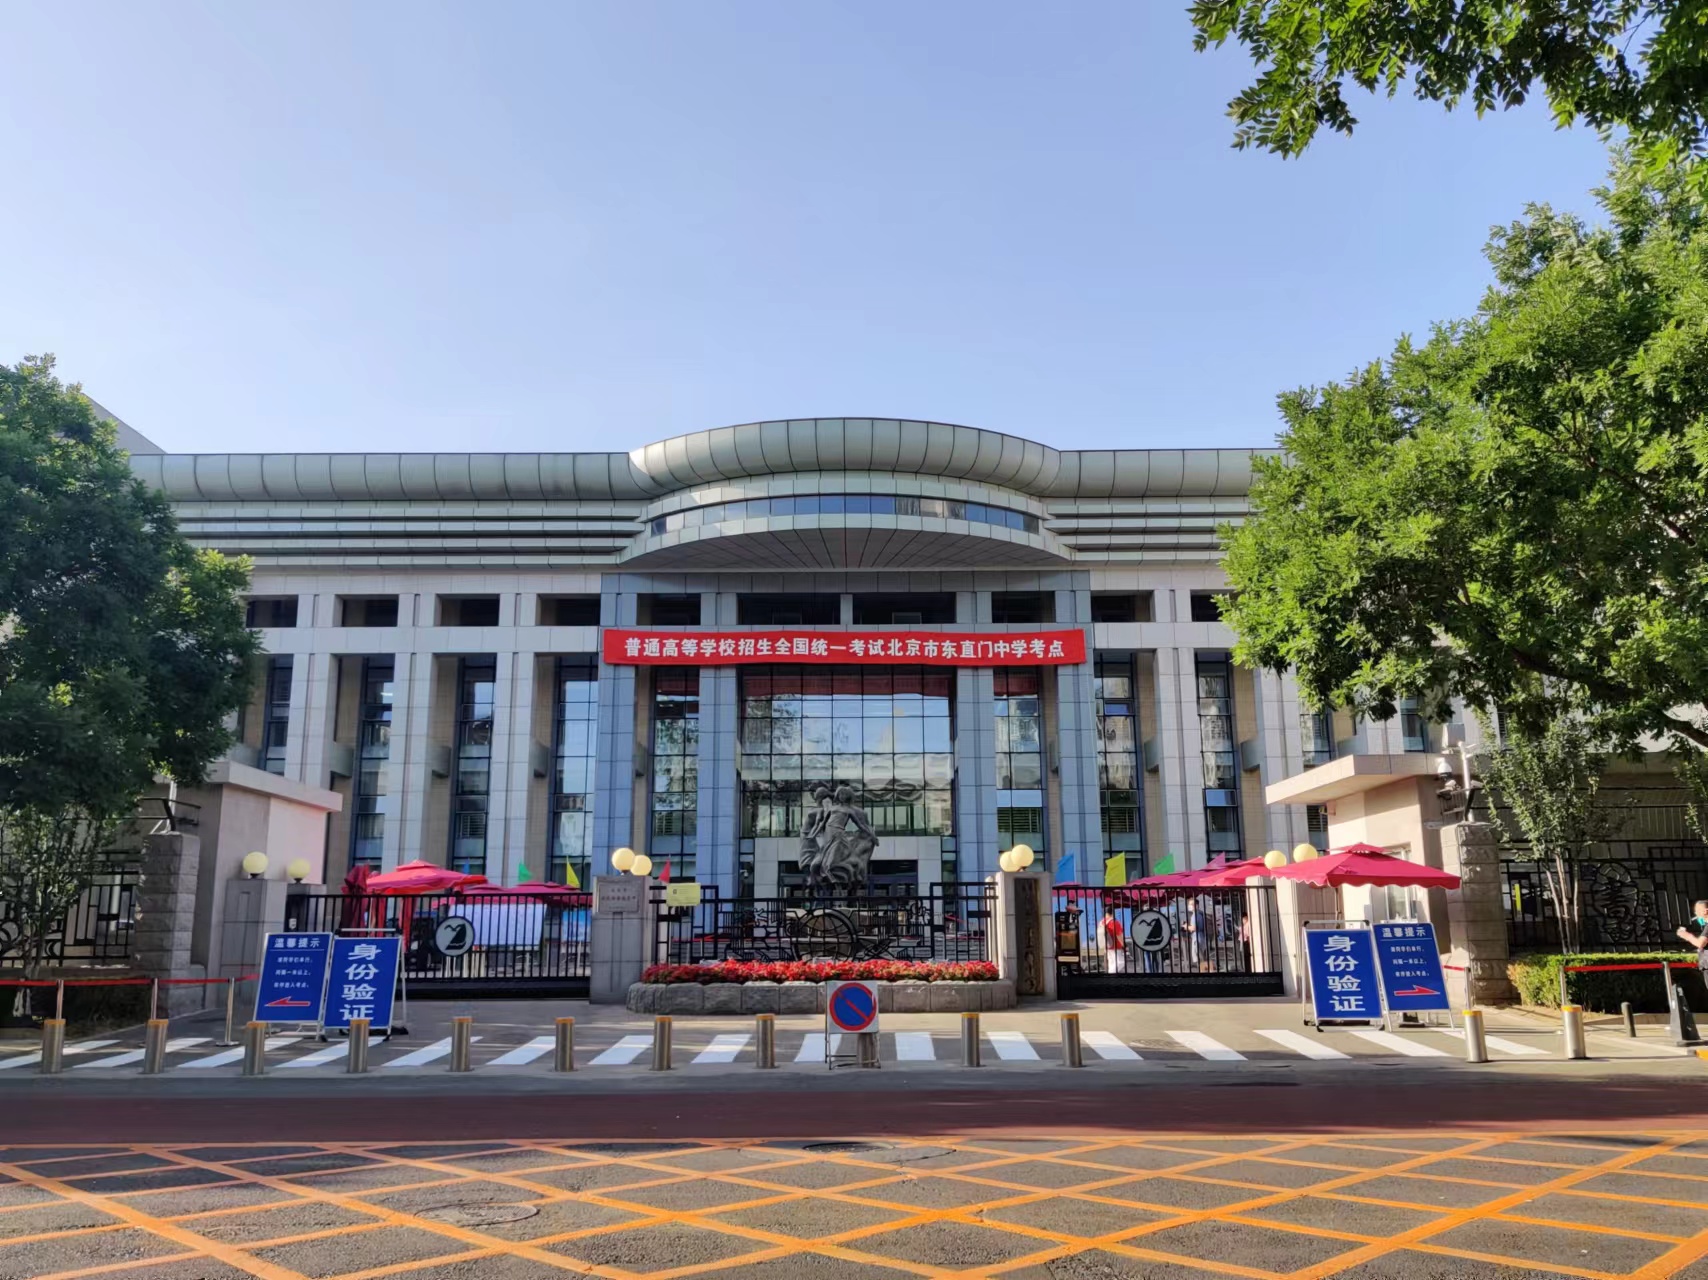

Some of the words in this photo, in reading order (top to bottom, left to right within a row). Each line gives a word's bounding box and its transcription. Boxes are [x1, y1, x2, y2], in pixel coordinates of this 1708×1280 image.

[624, 637, 1065, 659] 普通高等学校招生全国统一考试北京市东直门中学考点
[339, 943, 382, 1020] 身份验证
[1323, 935, 1366, 1012] 身份验证
